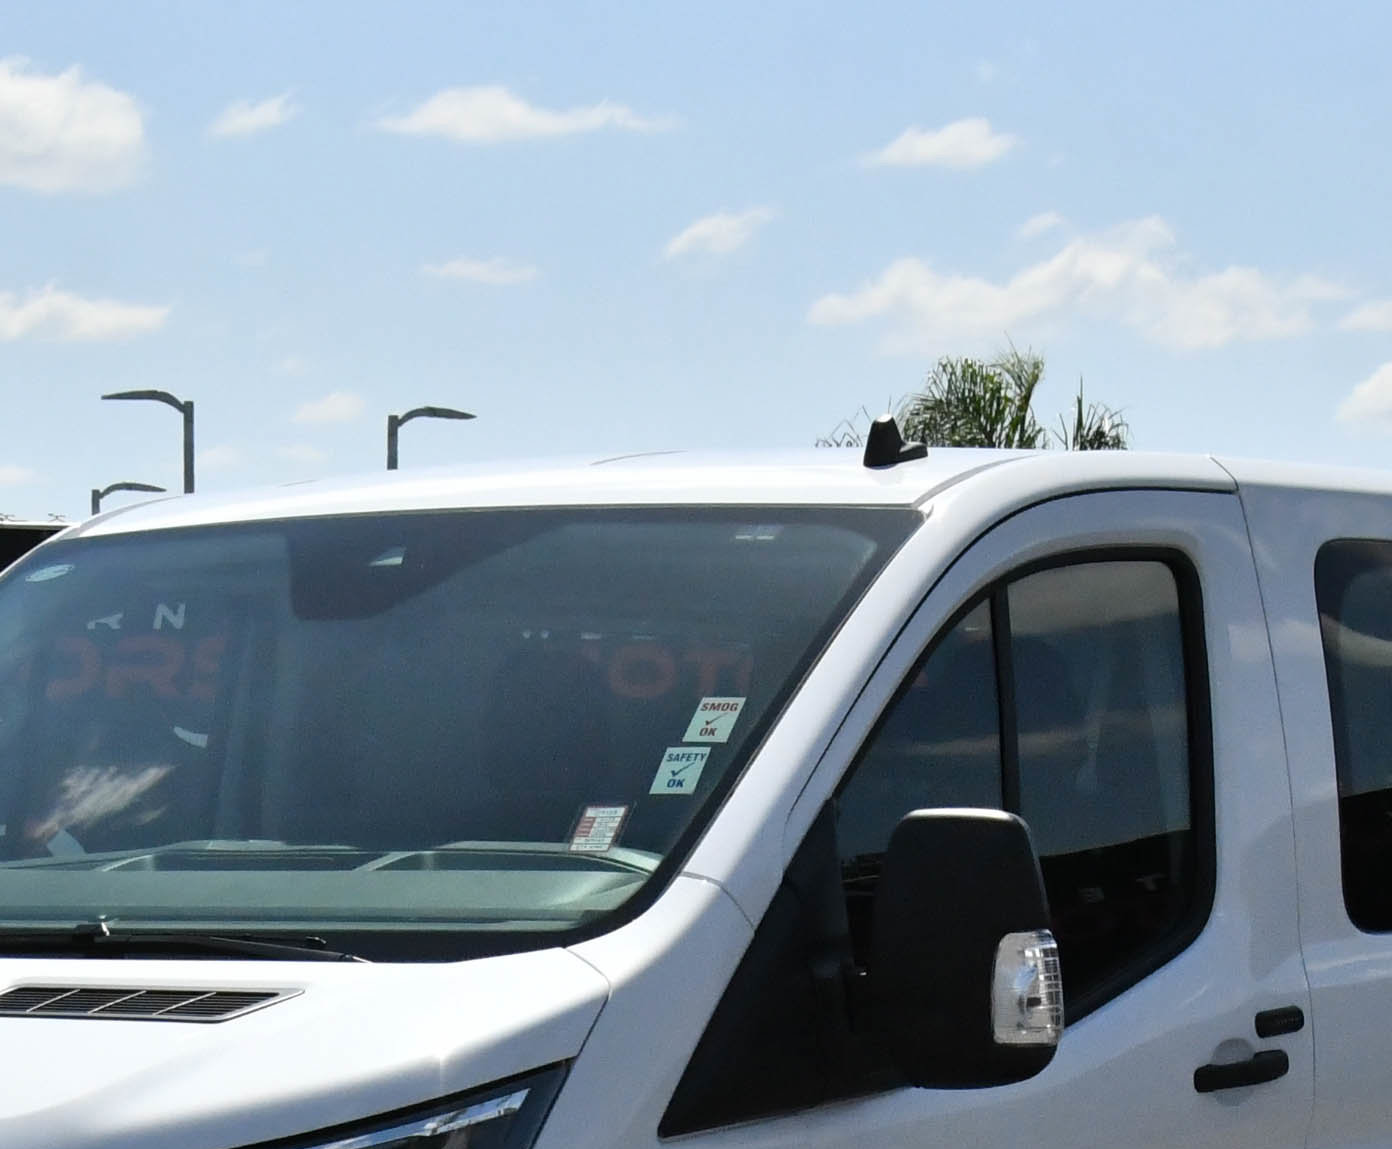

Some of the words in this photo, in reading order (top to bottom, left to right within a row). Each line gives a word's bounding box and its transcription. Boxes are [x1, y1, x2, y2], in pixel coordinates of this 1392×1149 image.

[700, 702, 739, 712] SMOG
[699, 727, 717, 737] OK
[666, 753, 707, 762] SAFETY
[666, 778, 685, 788] OK
